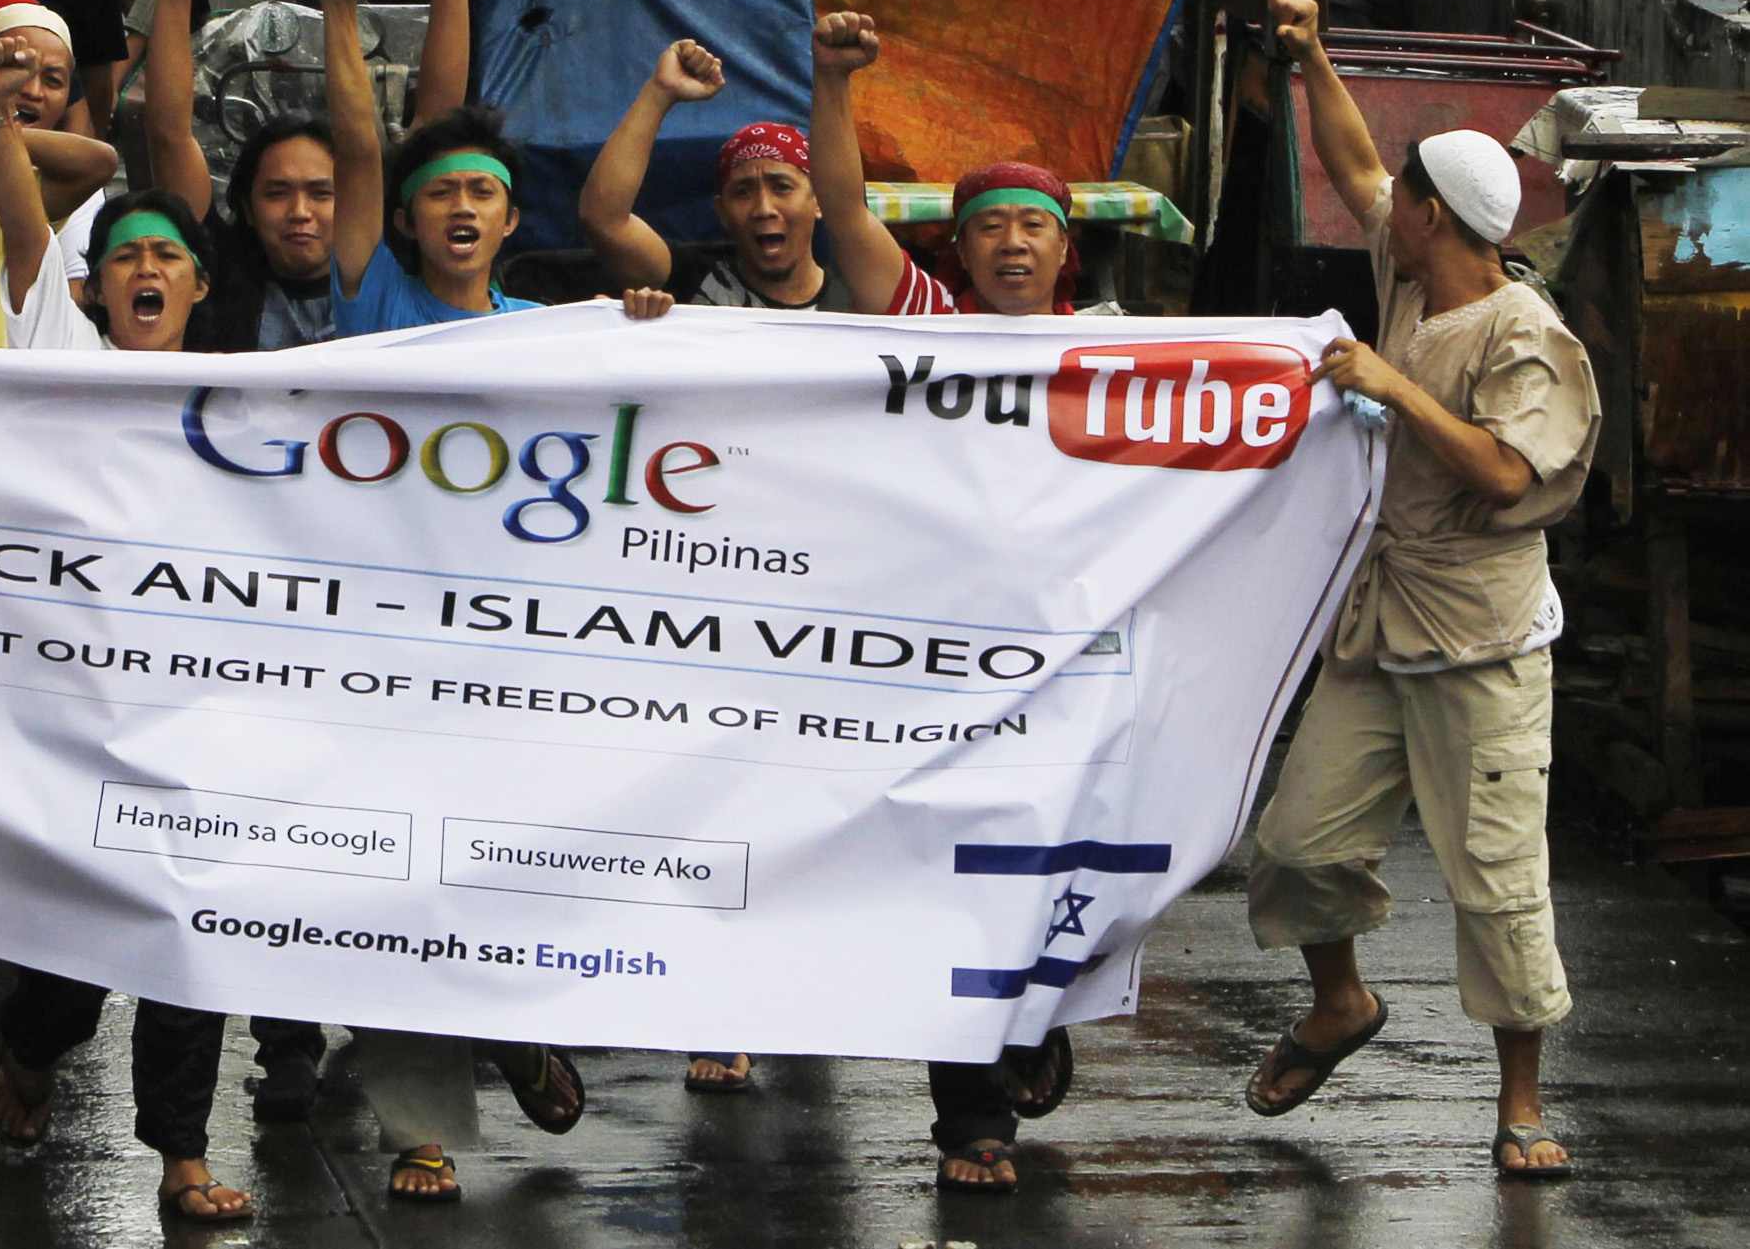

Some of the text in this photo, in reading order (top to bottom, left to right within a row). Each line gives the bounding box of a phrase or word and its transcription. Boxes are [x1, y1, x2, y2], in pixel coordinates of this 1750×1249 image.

[181, 385, 720, 543] Google
[621, 526, 811, 577] Pilipinas
[131, 560, 342, 617] ANTI
[440, 590, 722, 653] ISLAM
[754, 619, 1047, 680] VIDEO
[36, 638, 152, 673] OUR
[168, 653, 326, 690] RIGHT
[340, 670, 413, 697] OF
[431, 678, 689, 725] FREEDOM
[708, 705, 779, 732] OF
[115, 803, 397, 857] Hanapin sa Google
[469, 838, 713, 882] Sinusuwerte Ako
[190, 908, 668, 980] Google.com.ph sa: English
